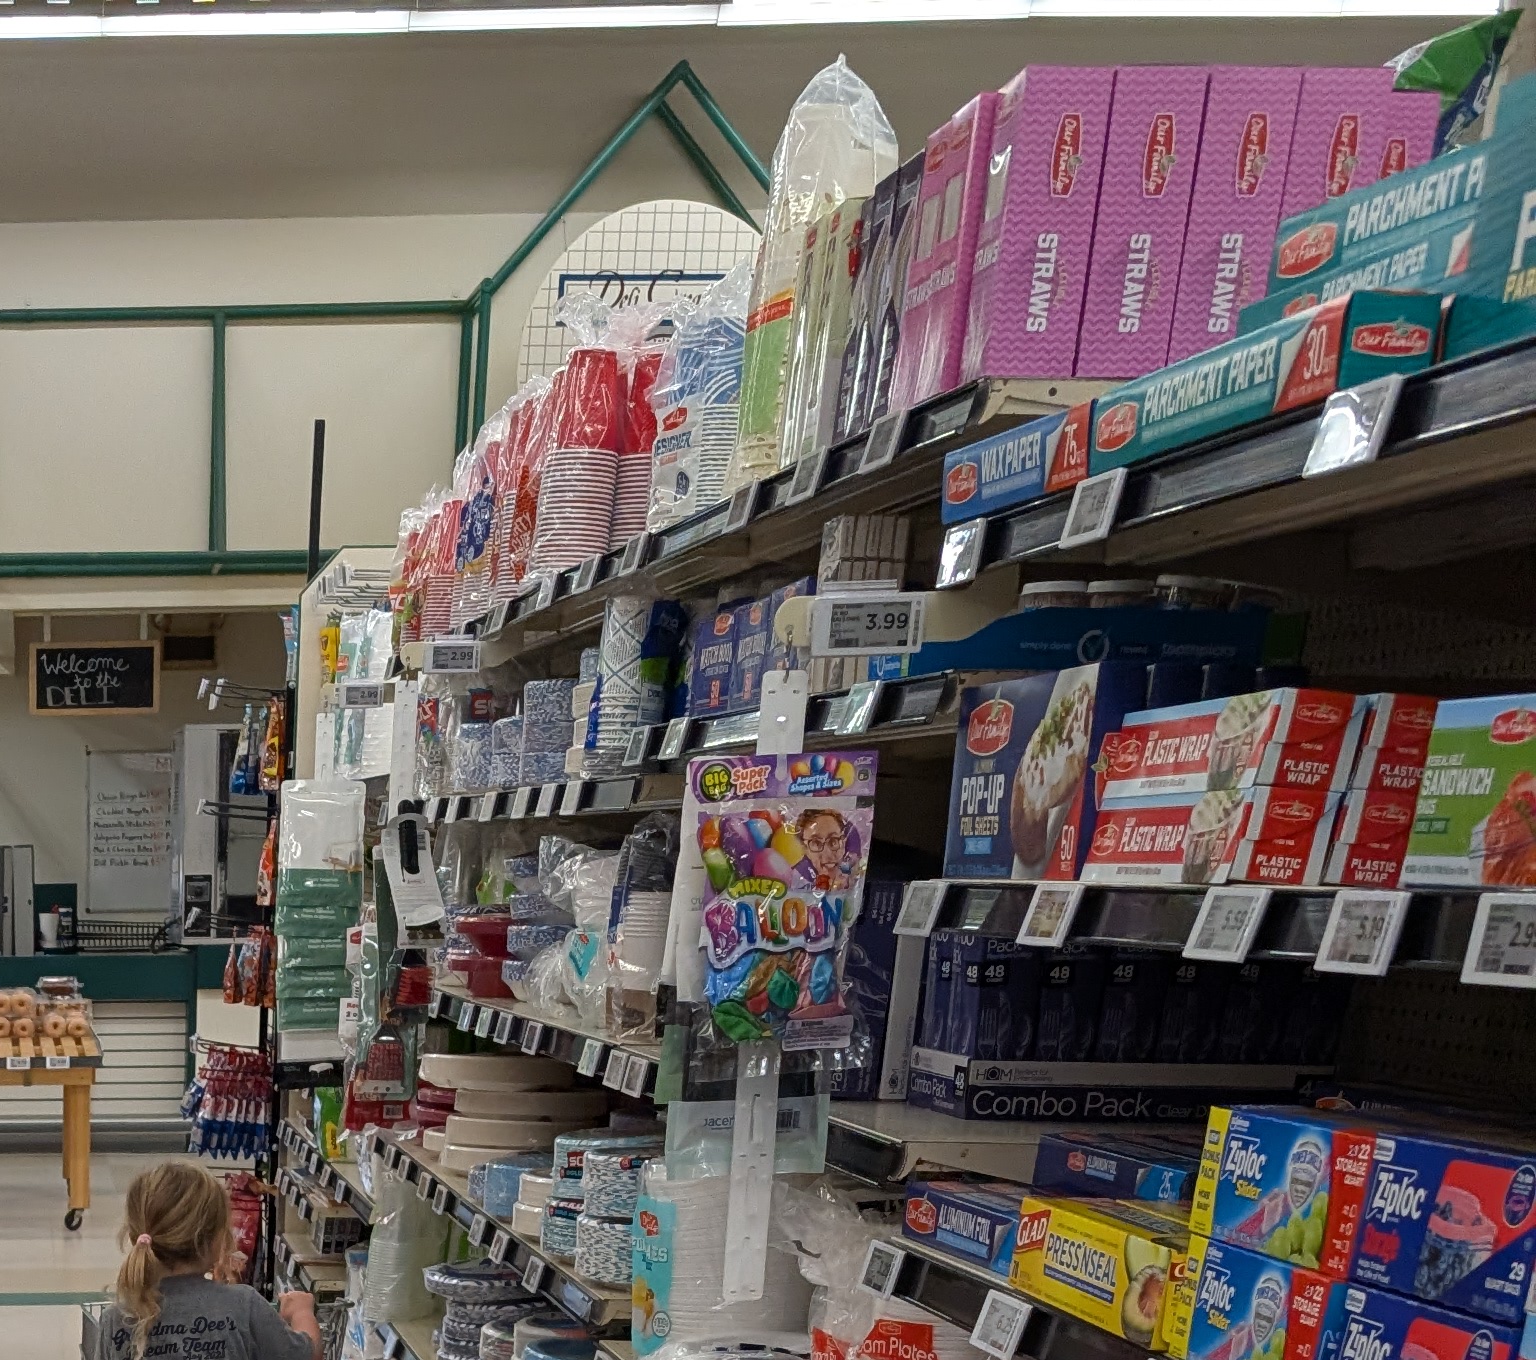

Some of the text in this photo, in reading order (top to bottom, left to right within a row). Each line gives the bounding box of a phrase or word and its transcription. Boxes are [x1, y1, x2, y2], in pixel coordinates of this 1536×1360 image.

[1343, 163, 1465, 247] PARCHMENT
[1026, 233, 1058, 332] STRAWS
[1118, 234, 1151, 333] STRAWS
[1207, 233, 1242, 333] STRAWS
[1357, 329, 1425, 351] Our Family
[1303, 325, 1327, 381] 30
[1142, 337, 1279, 426] PARCHMENT PAPER
[1064, 423, 1078, 468] 75
[981, 432, 1041, 484] WAX PAPER
[866, 613, 909, 630] 3.99
[40, 652, 130, 674] Welcome
[450, 651, 473, 660] 2.99
[73, 672, 120, 689] to the
[46, 685, 114, 706] DELI
[733, 767, 769, 782] Super
[1283, 759, 1330, 776] PLASTIC
[705, 772, 728, 785] BIG
[739, 780, 765, 793] Pack
[796, 773, 828, 785] Assorted
[1286, 771, 1322, 785] WRAP
[1382, 776, 1417, 788] WRAP
[1421, 767, 1496, 796] SANDWICH
[708, 784, 726, 794] BAG
[959, 774, 1005, 815] POP-UP
[1061, 825, 1075, 860] 50
[1255, 854, 1302, 870] PLASTIC
[1351, 858, 1396, 873] PLASTIC
[1259, 867, 1293, 879] WRAP
[1354, 870, 1389, 882] WRAP
[728, 879, 786, 898] MIXED
[984, 965, 1005, 978] 48
[1049, 966, 1070, 979] 48
[976, 1066, 1012, 1083] HOM
[971, 1090, 1077, 1118] Combo
[1083, 1091, 1152, 1118] Pack
[1162, 1171, 1175, 1200] 25
[1235, 1179, 1262, 1200] Slider
[1372, 1170, 1426, 1224] Ziploc
[938, 1204, 991, 1244] ALUMINUM FOIL
[1016, 1217, 1047, 1246] GLAD
[1509, 1262, 1525, 1282] 29
[1200, 1271, 1235, 1313] Ziploc
[190, 1317, 236, 1334] Dee's
